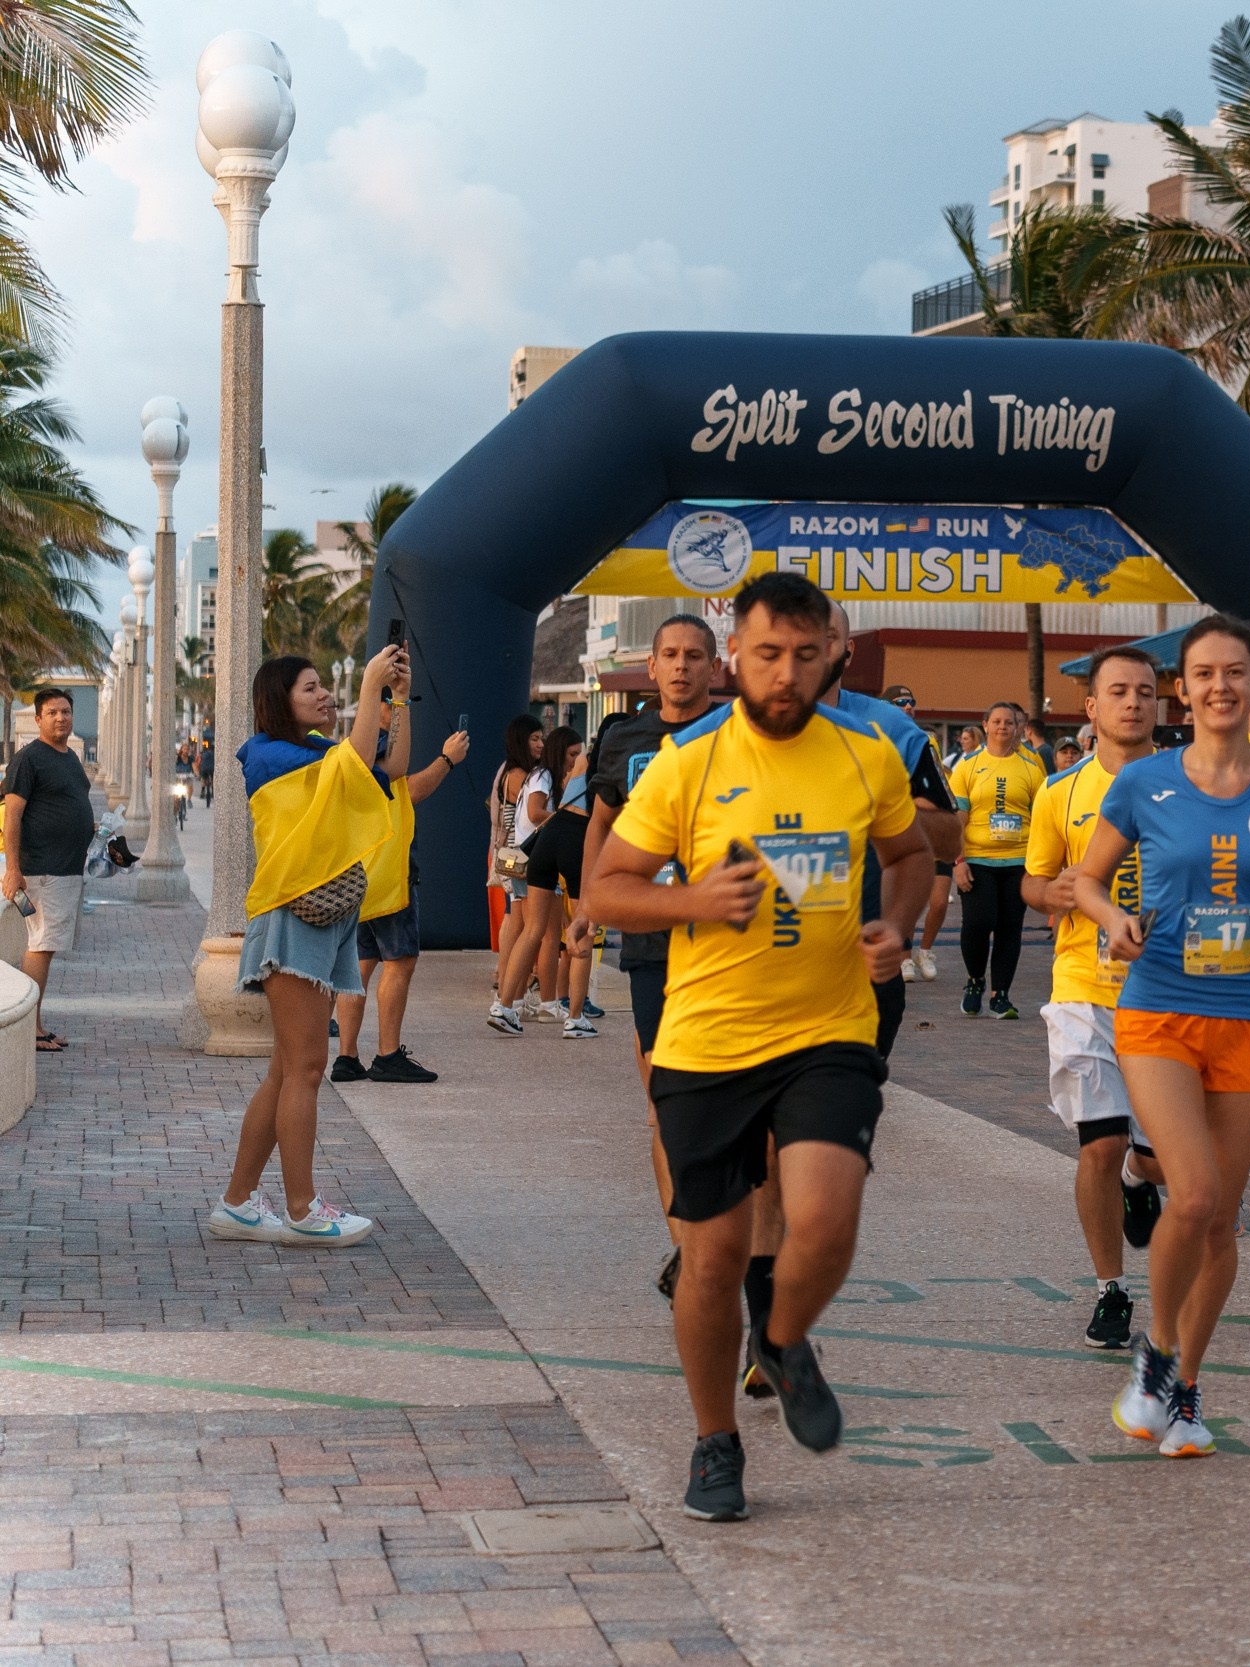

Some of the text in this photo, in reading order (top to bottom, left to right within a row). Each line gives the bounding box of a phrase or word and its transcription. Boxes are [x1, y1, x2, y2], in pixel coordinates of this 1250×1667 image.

[691, 384, 1116, 472] Split Second Timing
[789, 516, 989, 538] RAZOM RUN
[776, 546, 1003, 593] FINISH
[995, 777, 1007, 813] KRAINE
[997, 820, 1016, 832] 192
[1194, 907, 1230, 916] RAZOM
[1217, 921, 1247, 952] 17
